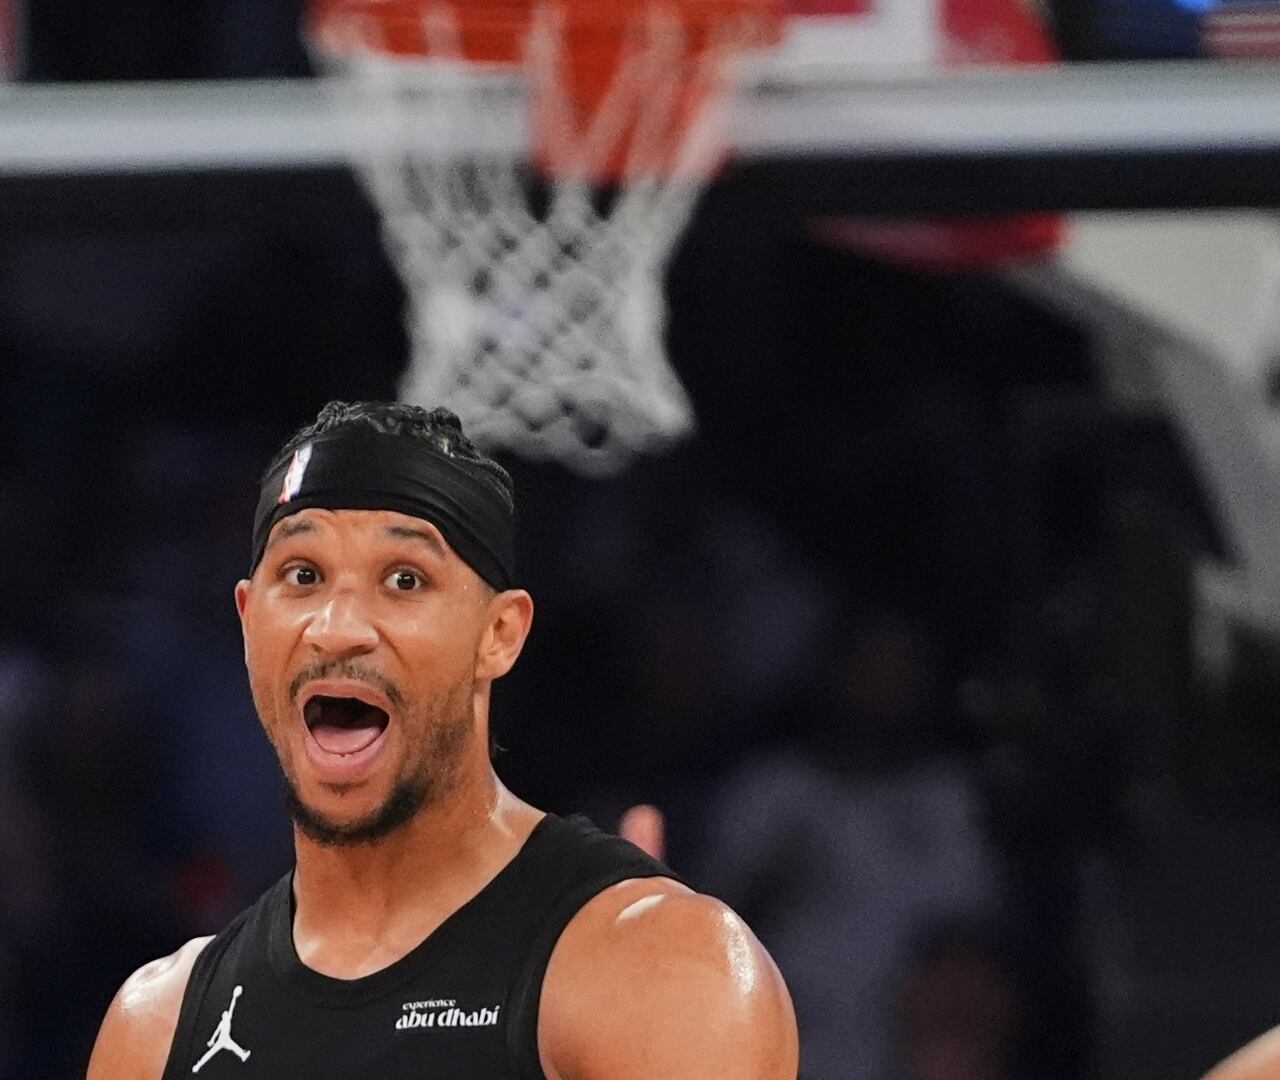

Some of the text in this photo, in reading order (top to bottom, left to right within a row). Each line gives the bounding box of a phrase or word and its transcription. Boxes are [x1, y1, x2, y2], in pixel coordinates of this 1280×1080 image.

[402, 999, 457, 1012] experience
[395, 1005, 500, 1030] abu dhabi
